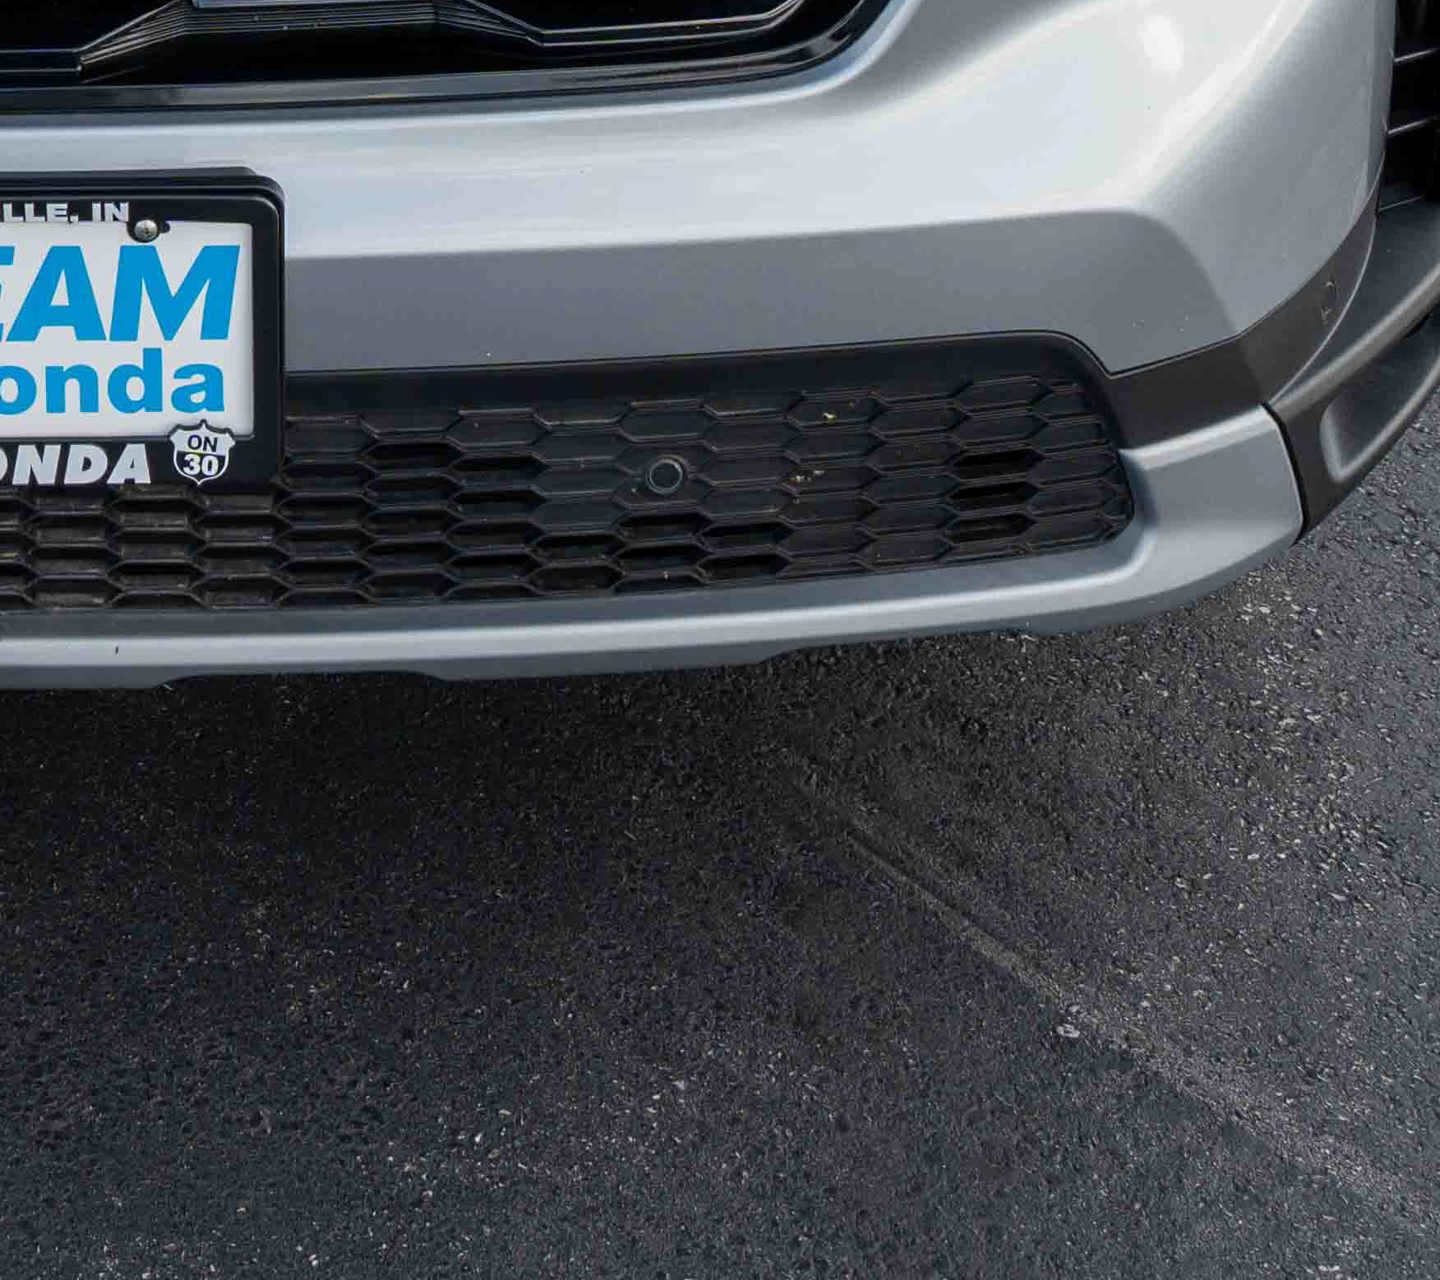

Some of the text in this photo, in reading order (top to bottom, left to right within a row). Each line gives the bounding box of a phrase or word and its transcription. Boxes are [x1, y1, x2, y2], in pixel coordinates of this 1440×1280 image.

[90, 201, 131, 223] IN
[187, 434, 219, 453] ON
[182, 453, 219, 476] 30
